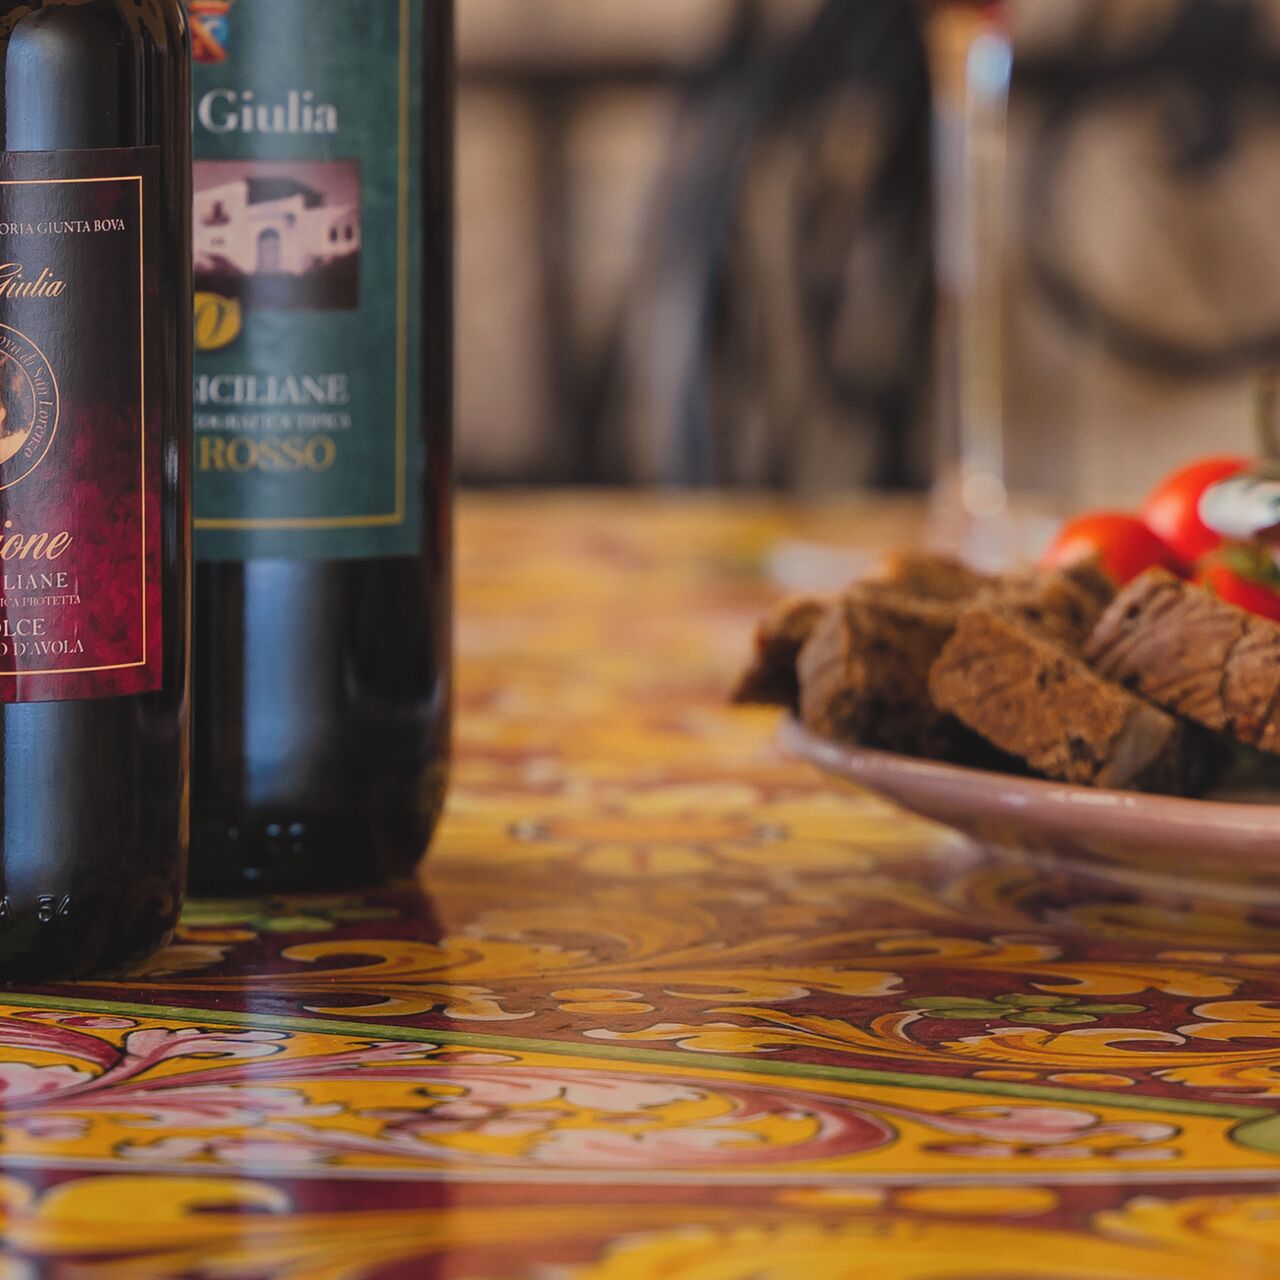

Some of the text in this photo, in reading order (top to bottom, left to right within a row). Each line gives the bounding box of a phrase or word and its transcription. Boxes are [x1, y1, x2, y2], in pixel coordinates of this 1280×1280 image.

[197, 86, 338, 134] Giulia
[37, 220, 91, 234] GIUNTA
[94, 218, 125, 232] BOVA
[32, 366, 49, 397] San
[193, 372, 351, 406] ICILIANE
[198, 433, 338, 473] ROSSO
[23, 594, 82, 608] PROTETTA
[13, 639, 84, 658] D'AVOLA
